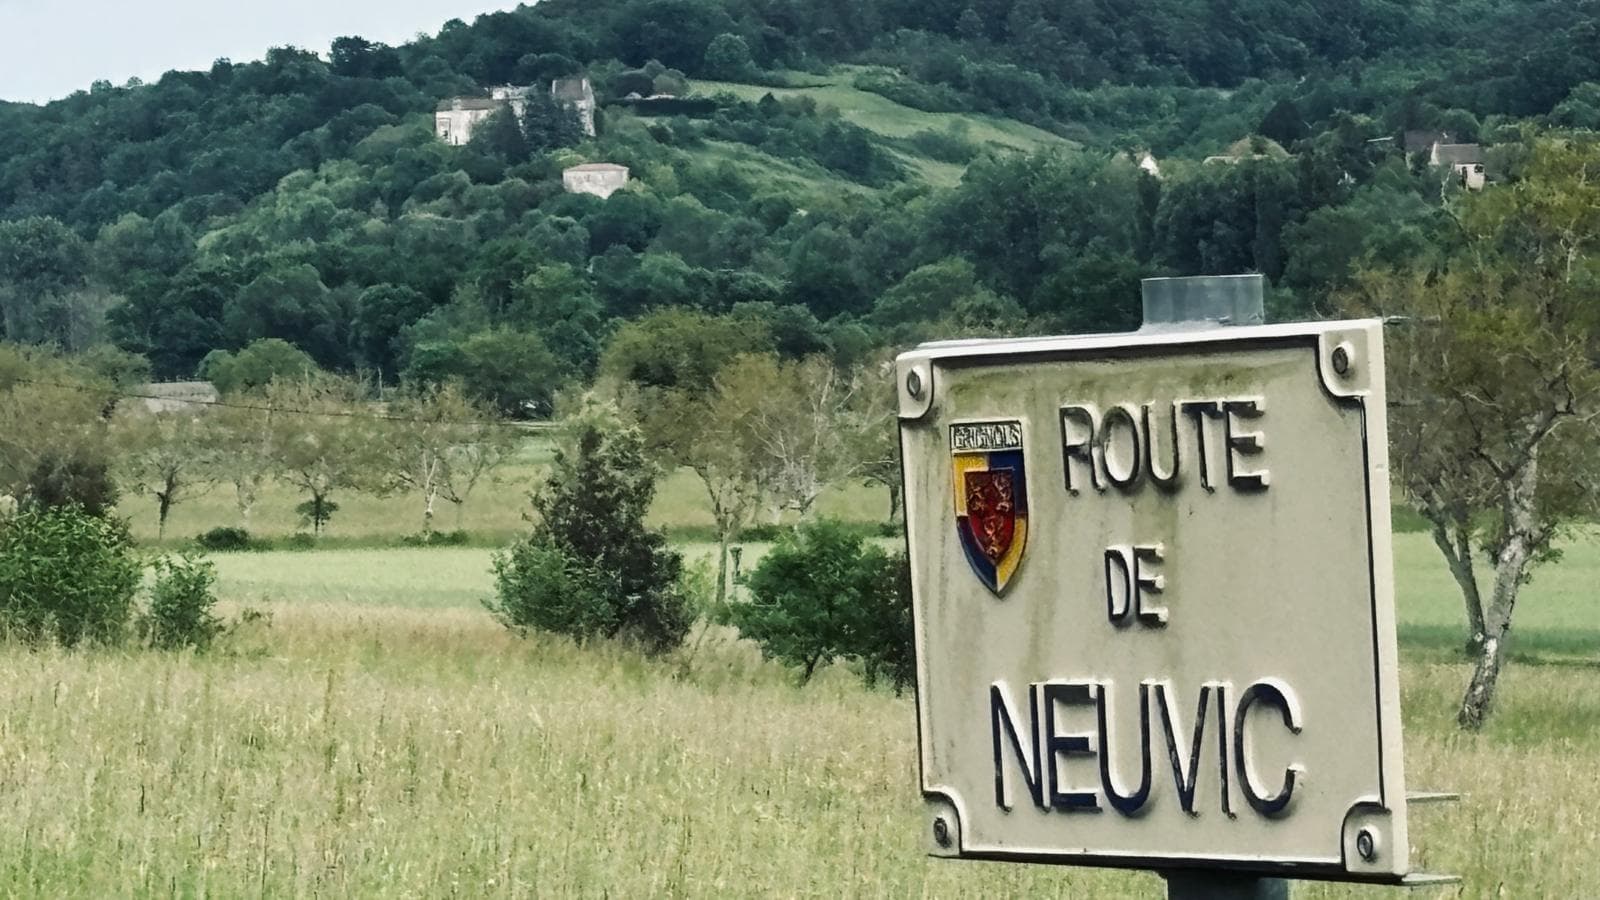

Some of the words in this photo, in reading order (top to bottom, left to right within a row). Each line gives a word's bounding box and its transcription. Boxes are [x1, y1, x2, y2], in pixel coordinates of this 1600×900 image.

[1060, 396, 1270, 494] ROUTE
[1104, 545, 1169, 627] DE
[990, 678, 1304, 817] NEUVIC
